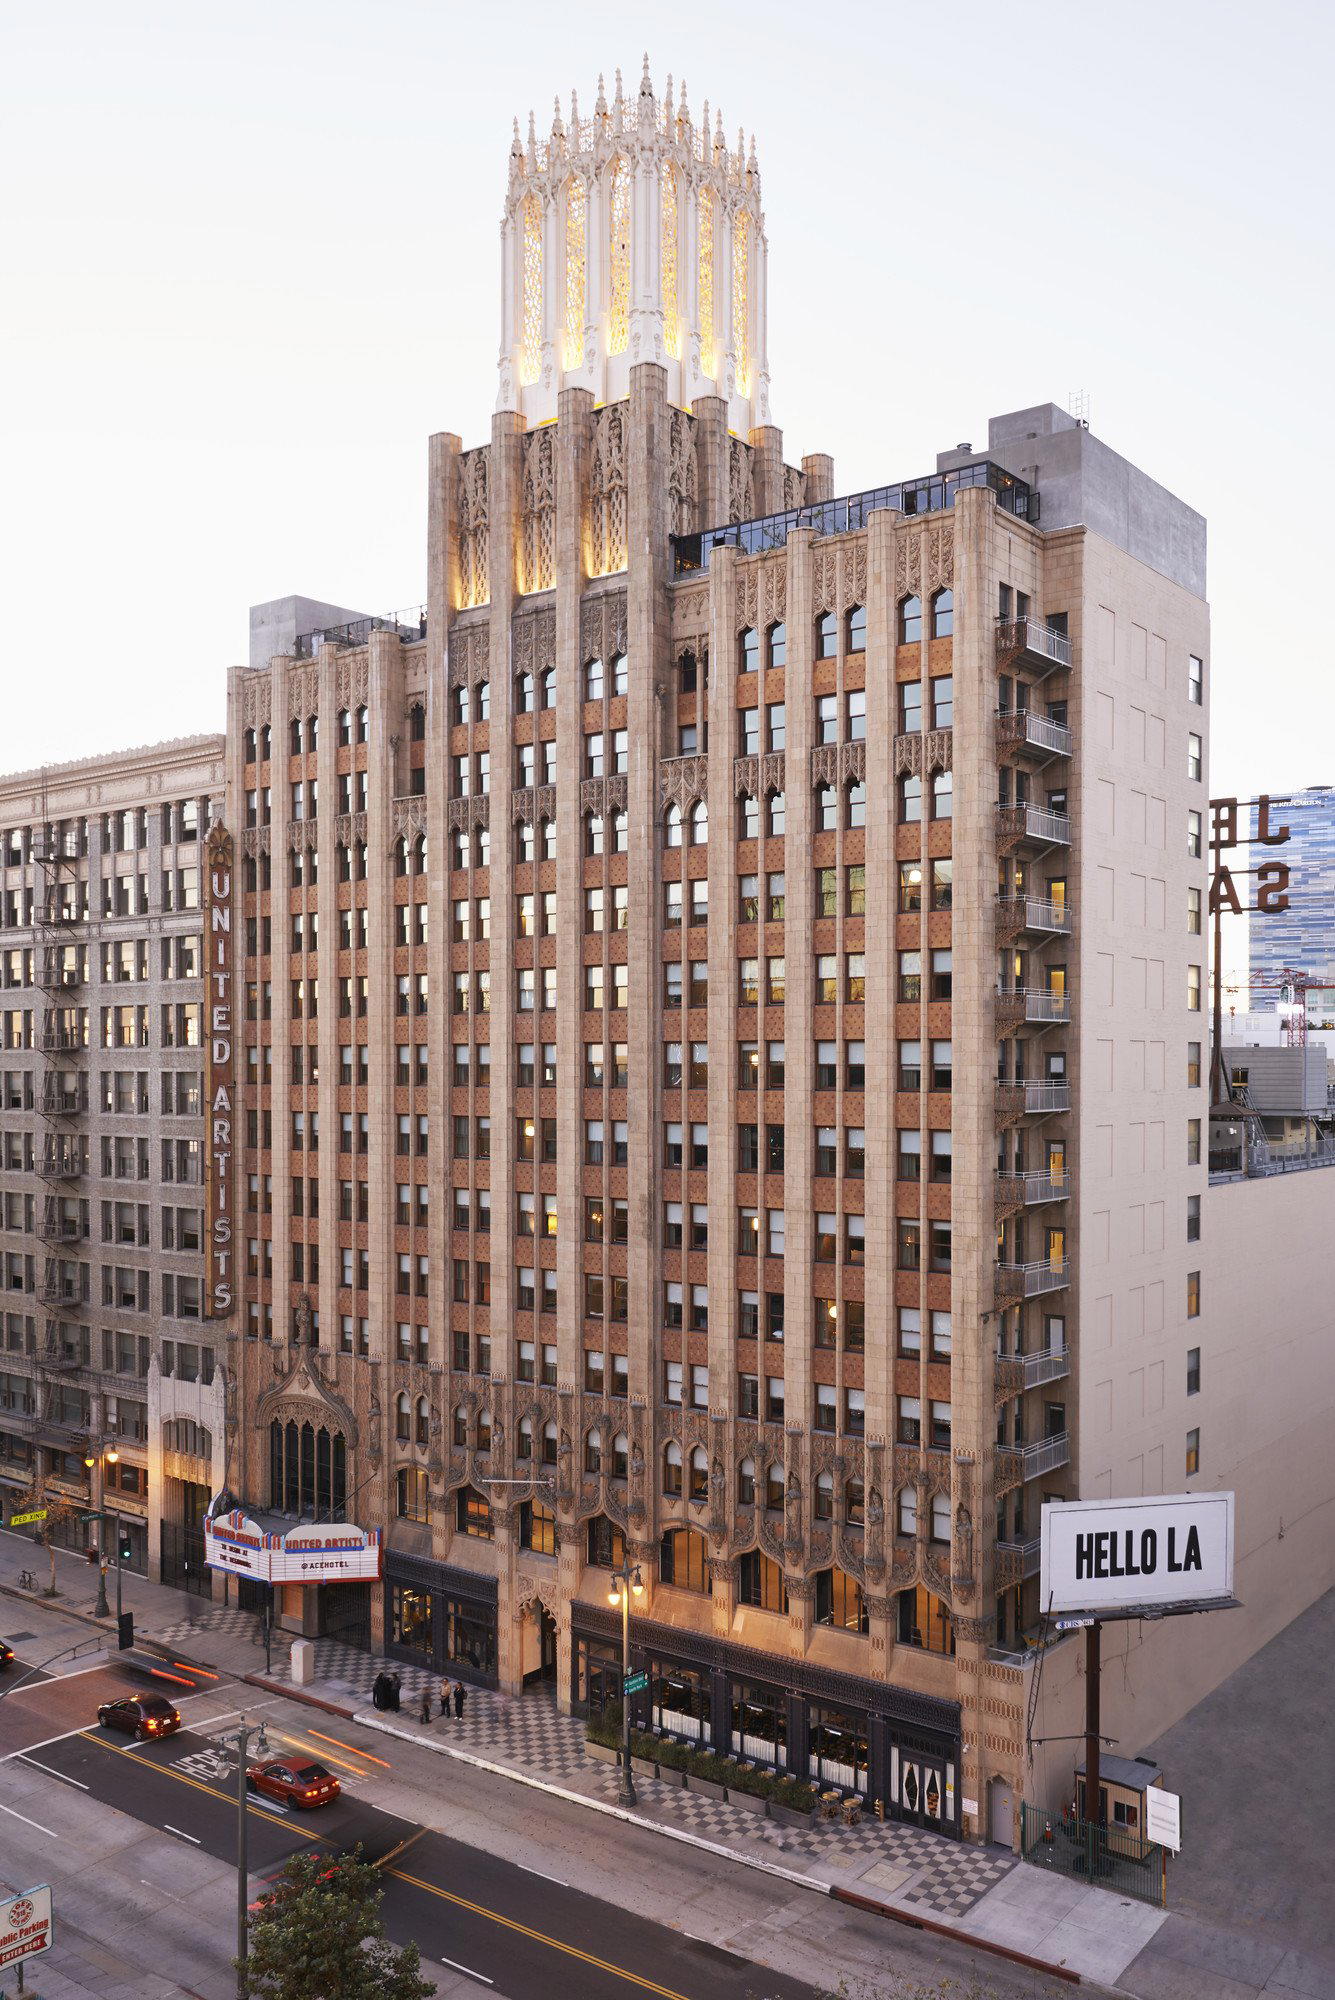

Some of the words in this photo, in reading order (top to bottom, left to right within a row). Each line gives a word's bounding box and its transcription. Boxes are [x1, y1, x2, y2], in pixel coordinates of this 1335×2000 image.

[212, 872, 232, 1065] UNITED
[212, 1085, 232, 1309] ARTISTS
[14, 1515, 27, 1524] PED
[29, 1511, 44, 1519] XING
[286, 1538, 322, 1550] UNITED
[325, 1536, 363, 1548] ARTISTS
[1076, 1528, 1157, 1579] HELLO
[1167, 1525, 1202, 1572] LA
[19, 1918, 49, 1938] Parking
[2, 1947, 23, 1962] ENTER
[24, 1939, 41, 1952] HERE
